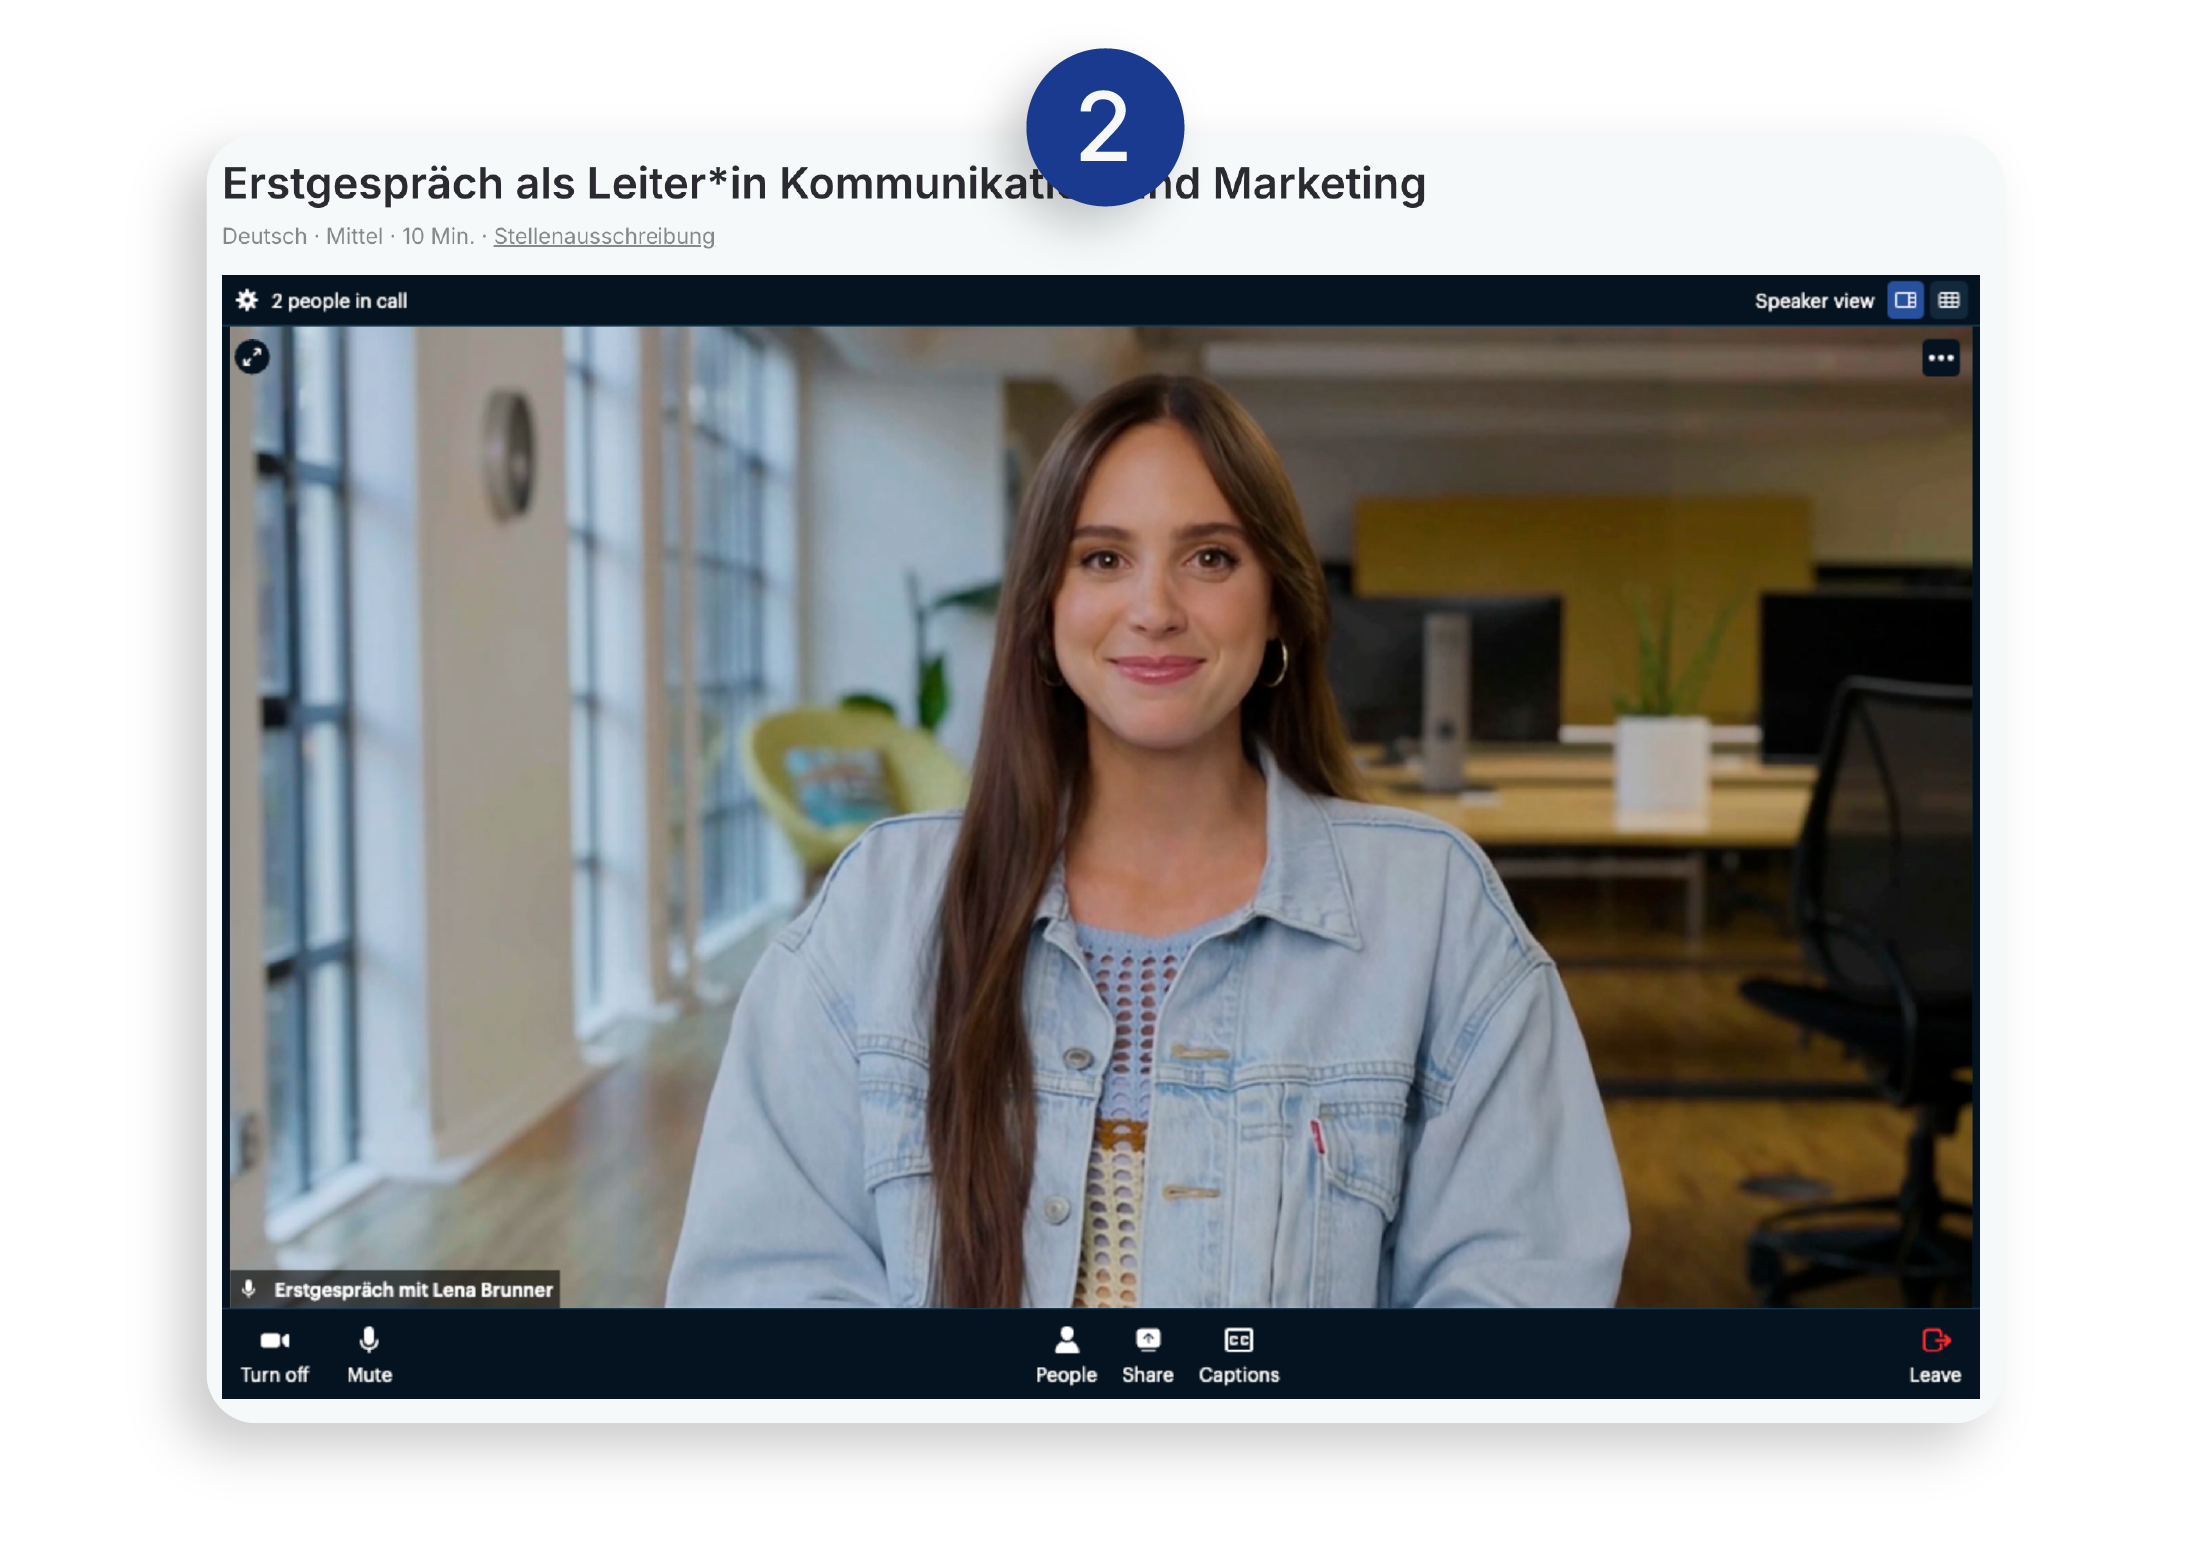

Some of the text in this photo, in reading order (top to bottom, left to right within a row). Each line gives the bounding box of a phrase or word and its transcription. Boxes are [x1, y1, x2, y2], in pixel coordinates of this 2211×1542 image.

[223, 164, 502, 208] Erstgespräch
[516, 166, 575, 200] als
[781, 164, 1074, 200] Kommunikati
[1215, 164, 1425, 209] Marketing
[222, 226, 715, 250] Deutsch Mittel 10 Min. Stellenausschreibung
[271, 291, 408, 313] 2 people in call
[1755, 291, 1876, 313] Speaker view
[275, 1280, 554, 1302] Erstgespräch mit Lena Brunner
[240, 1365, 311, 1383] Turn off
[347, 1366, 394, 1383] Mute
[1036, 1365, 1098, 1386] People
[1122, 1365, 1175, 1383] Share
[1198, 1366, 1281, 1387] Captions
[1910, 1366, 1963, 1383] Leave
